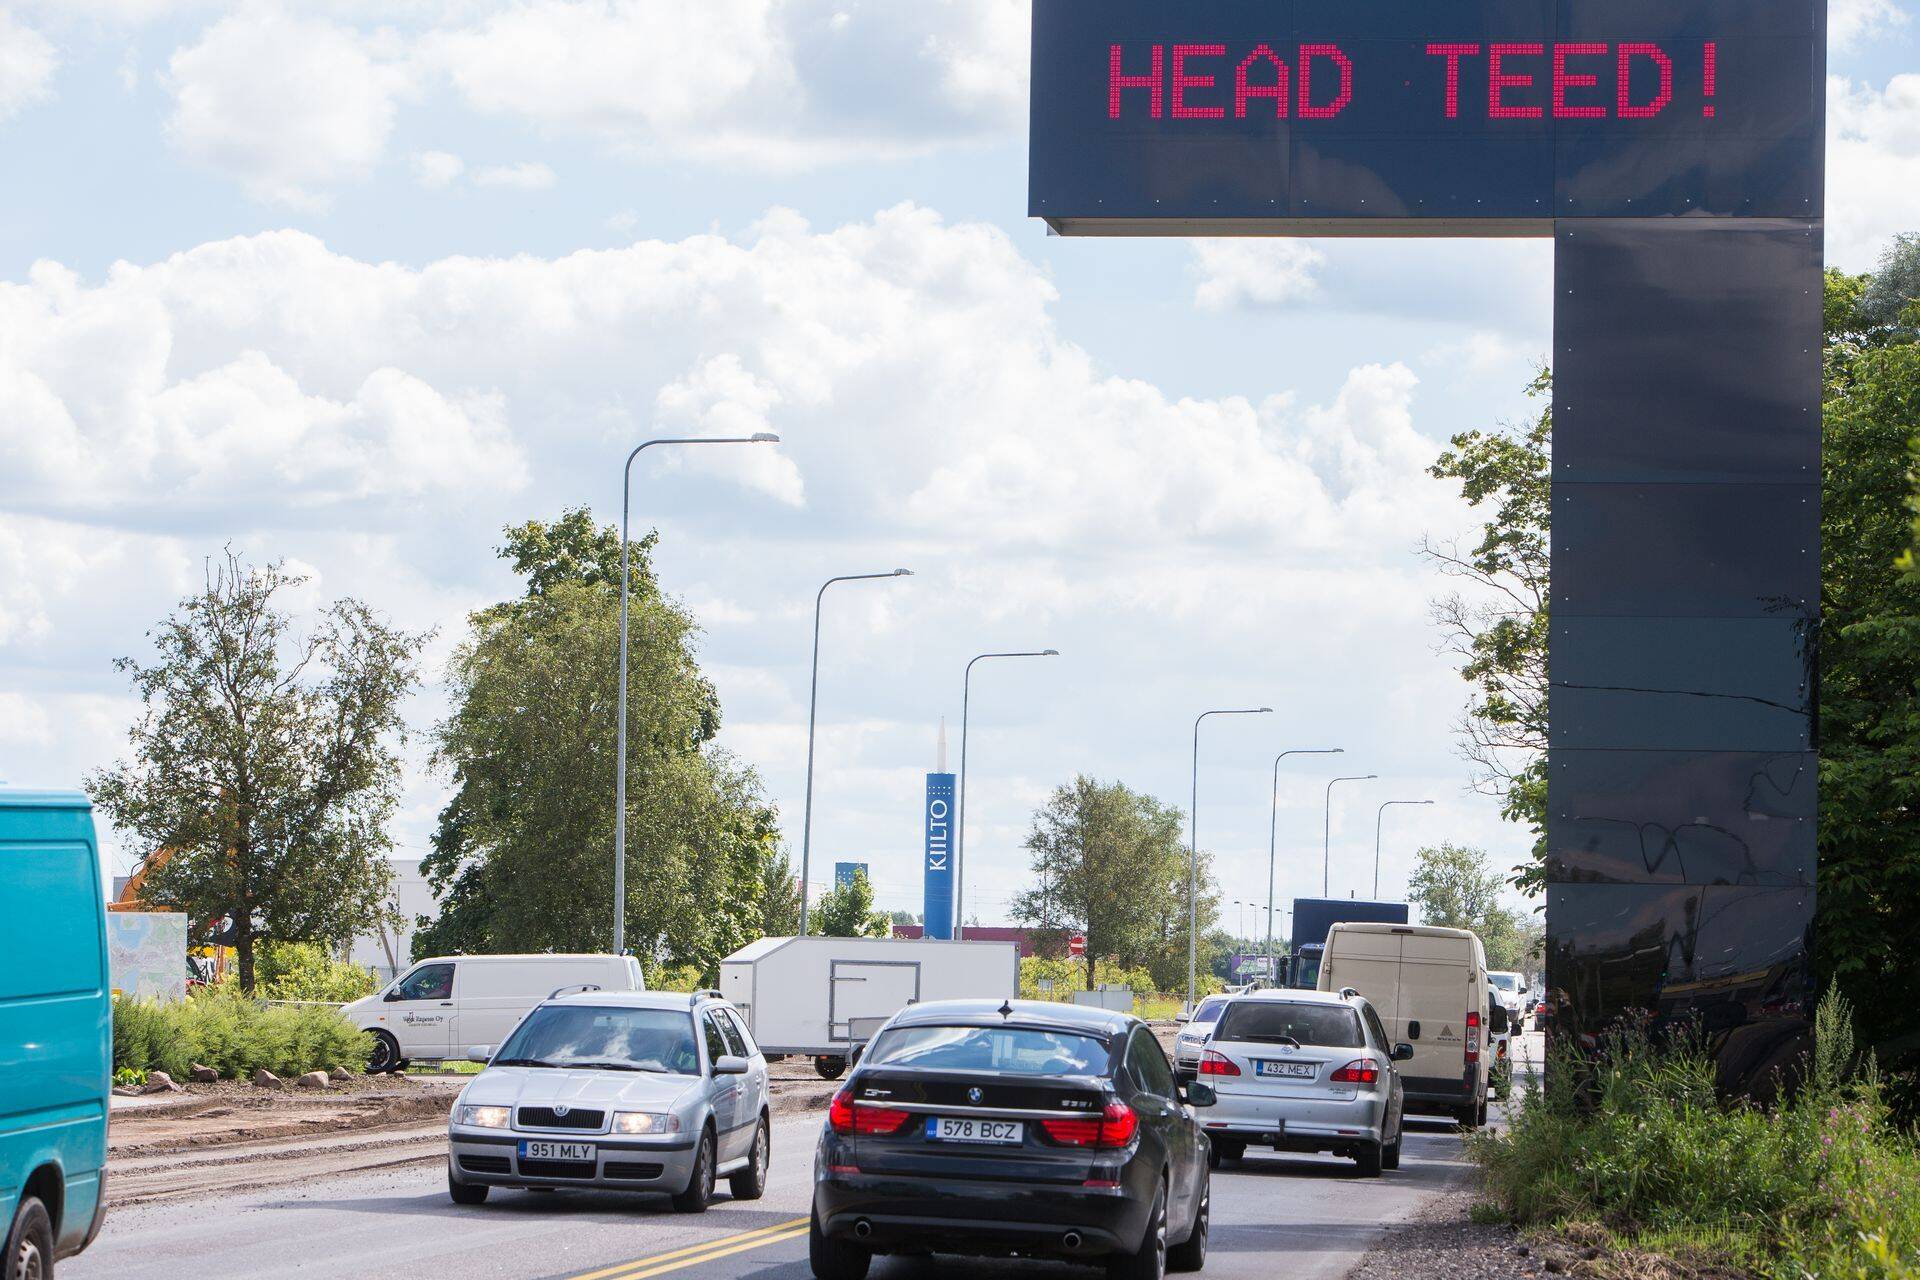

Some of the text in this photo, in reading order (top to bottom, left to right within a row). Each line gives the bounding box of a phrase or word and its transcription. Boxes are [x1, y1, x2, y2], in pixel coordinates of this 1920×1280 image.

[1108, 42, 1717, 119] HEAD TEED!
[929, 799, 948, 871] KIILTO
[1266, 1063, 1310, 1076] 432 MEX
[943, 1120, 1017, 1140] 578 BCZ
[531, 1143, 591, 1159] 951 MLY
